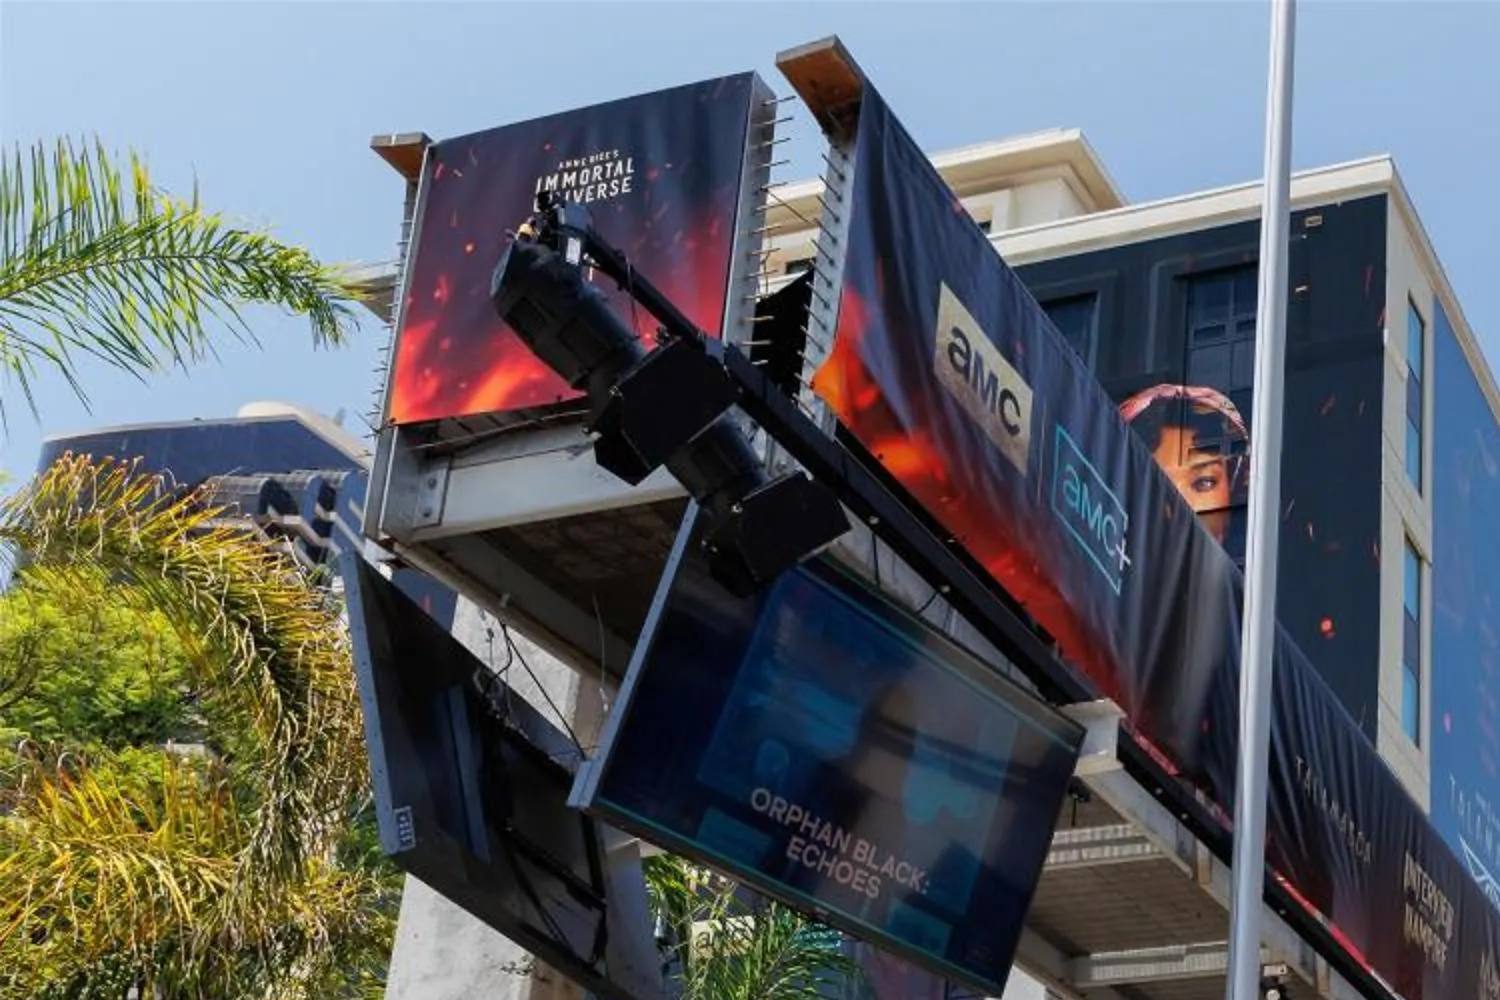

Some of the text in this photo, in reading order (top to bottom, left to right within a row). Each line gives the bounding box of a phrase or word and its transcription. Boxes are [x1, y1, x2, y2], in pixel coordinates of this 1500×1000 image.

[535, 158, 635, 195] IMMORTAL
[751, 787, 931, 896] ORPHAN BLACK:
[786, 836, 882, 899] ECHOES
